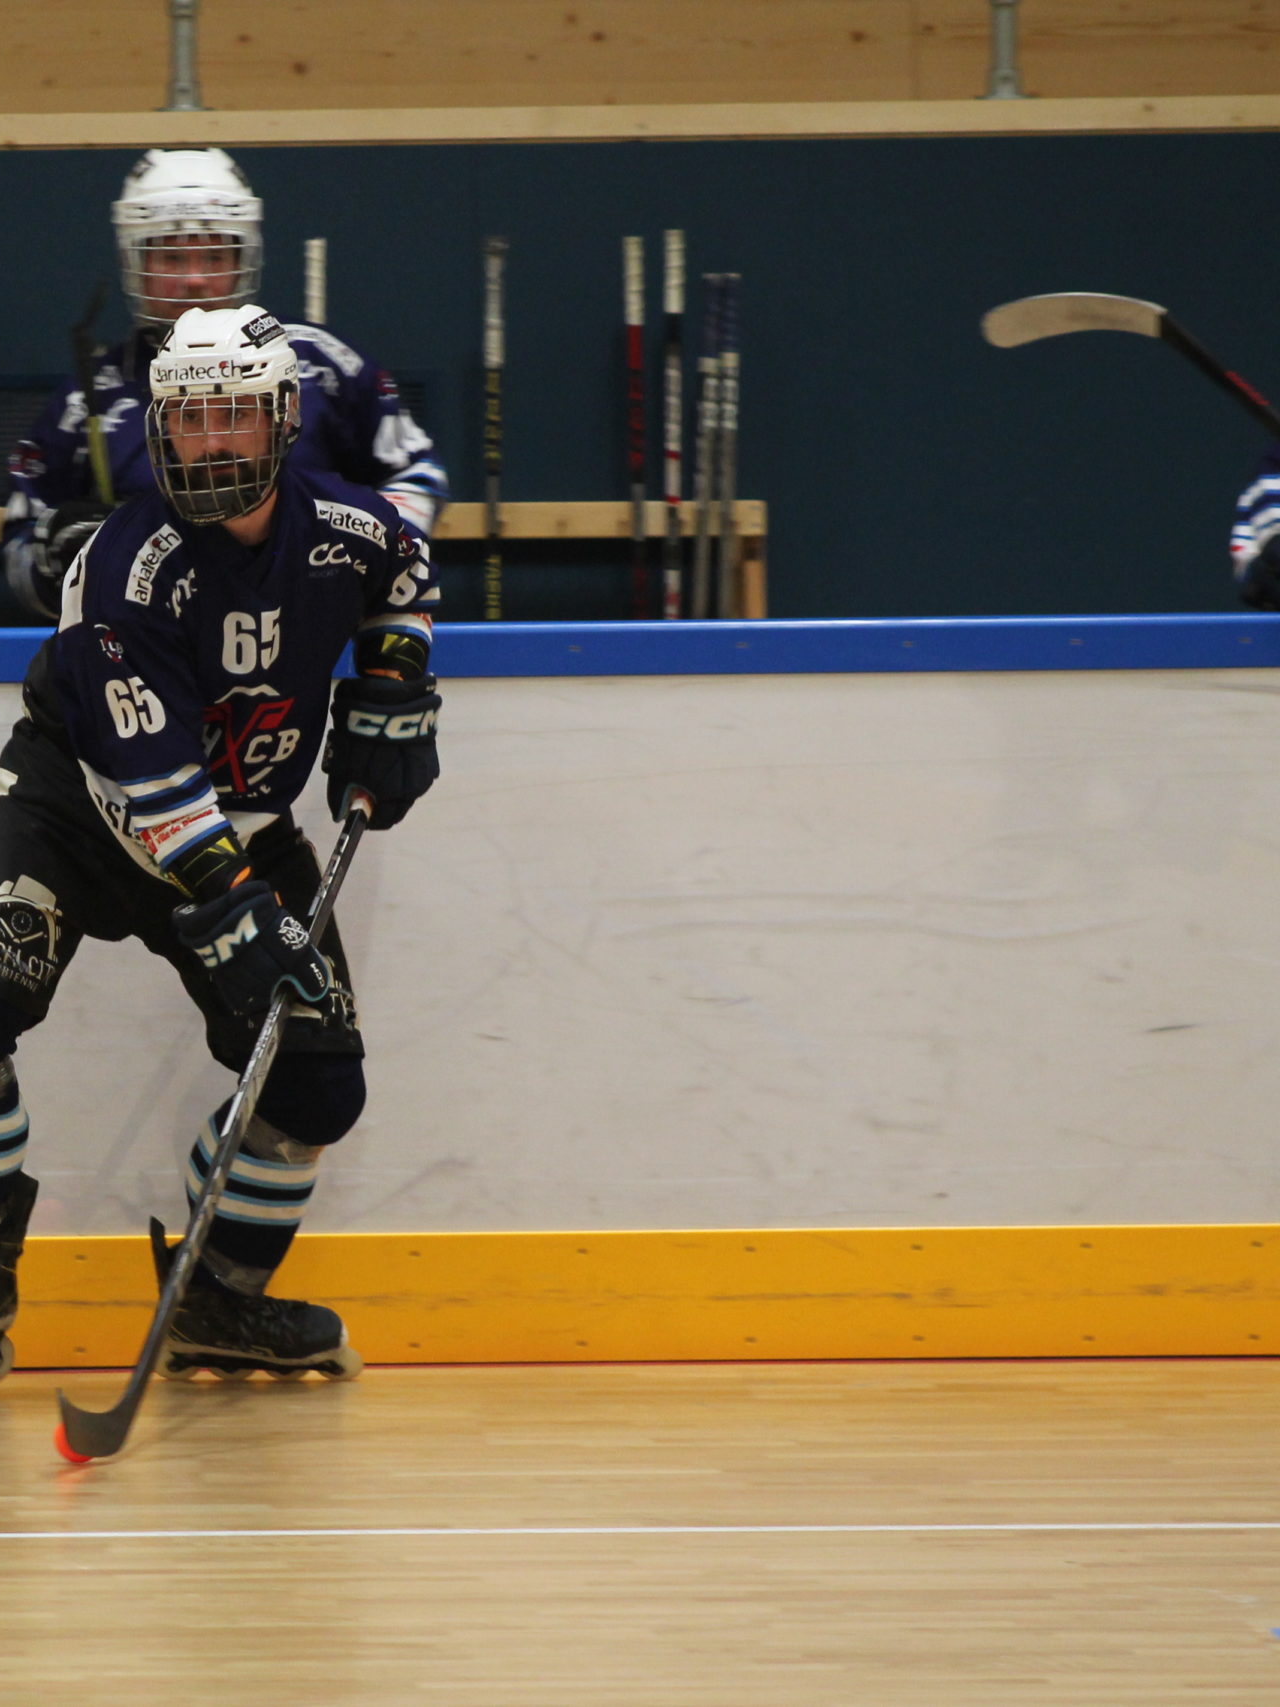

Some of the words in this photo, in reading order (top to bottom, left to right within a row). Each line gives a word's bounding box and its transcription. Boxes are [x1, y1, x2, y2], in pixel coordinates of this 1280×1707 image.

[160, 359, 242, 381] ariatec.ch
[222, 606, 281, 675] 65
[105, 676, 166, 739] 65
[347, 709, 440, 740] CCM
